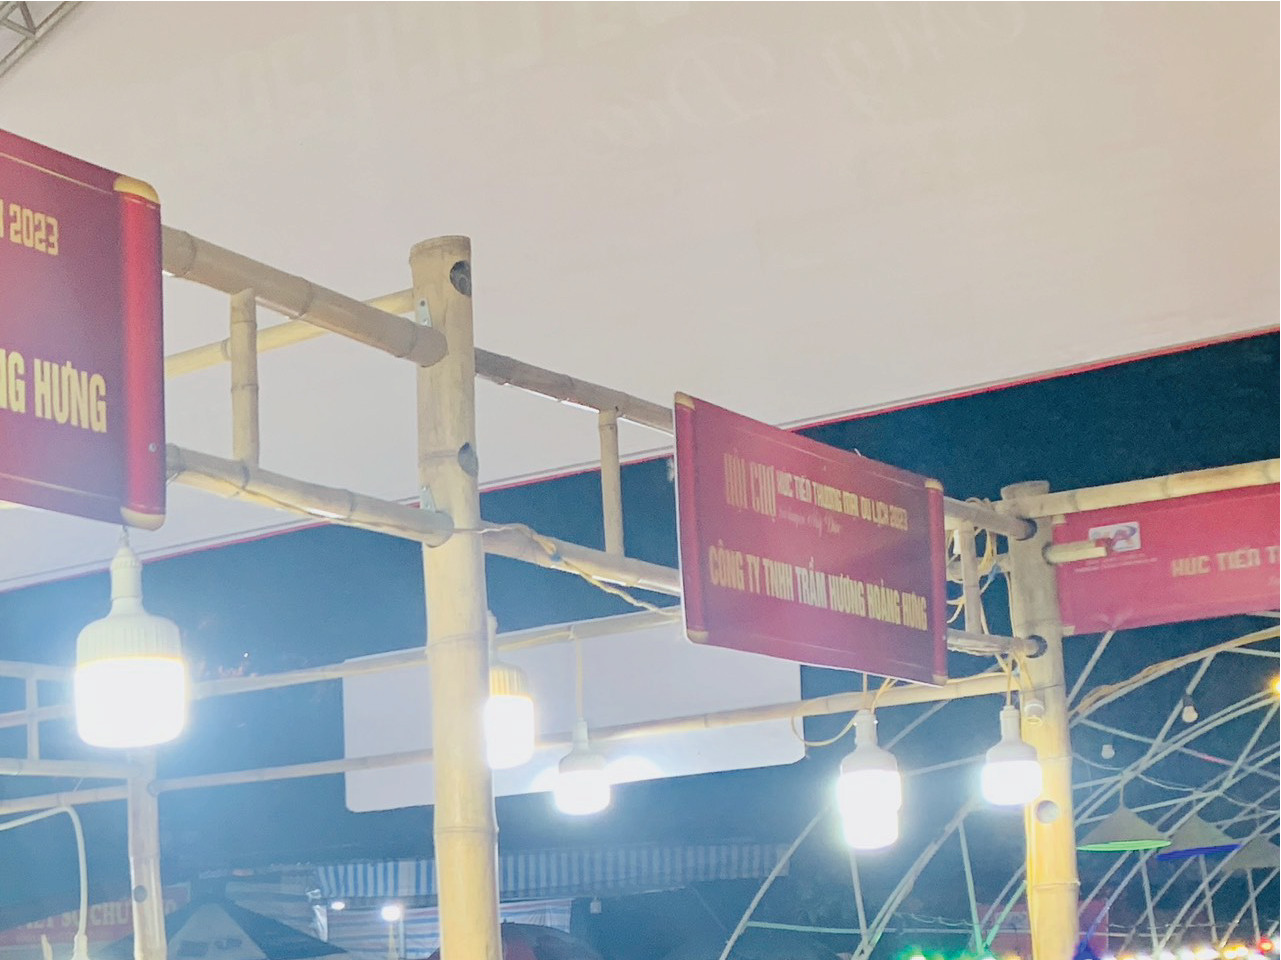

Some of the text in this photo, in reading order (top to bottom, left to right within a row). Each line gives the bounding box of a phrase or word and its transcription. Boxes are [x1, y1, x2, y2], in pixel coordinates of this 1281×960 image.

[9, 204, 60, 256] 2023
[33, 358, 109, 433] HƯNG
[708, 539, 746, 590] CÔNG
[746, 554, 761, 594] TY
[762, 557, 795, 601] TNHH
